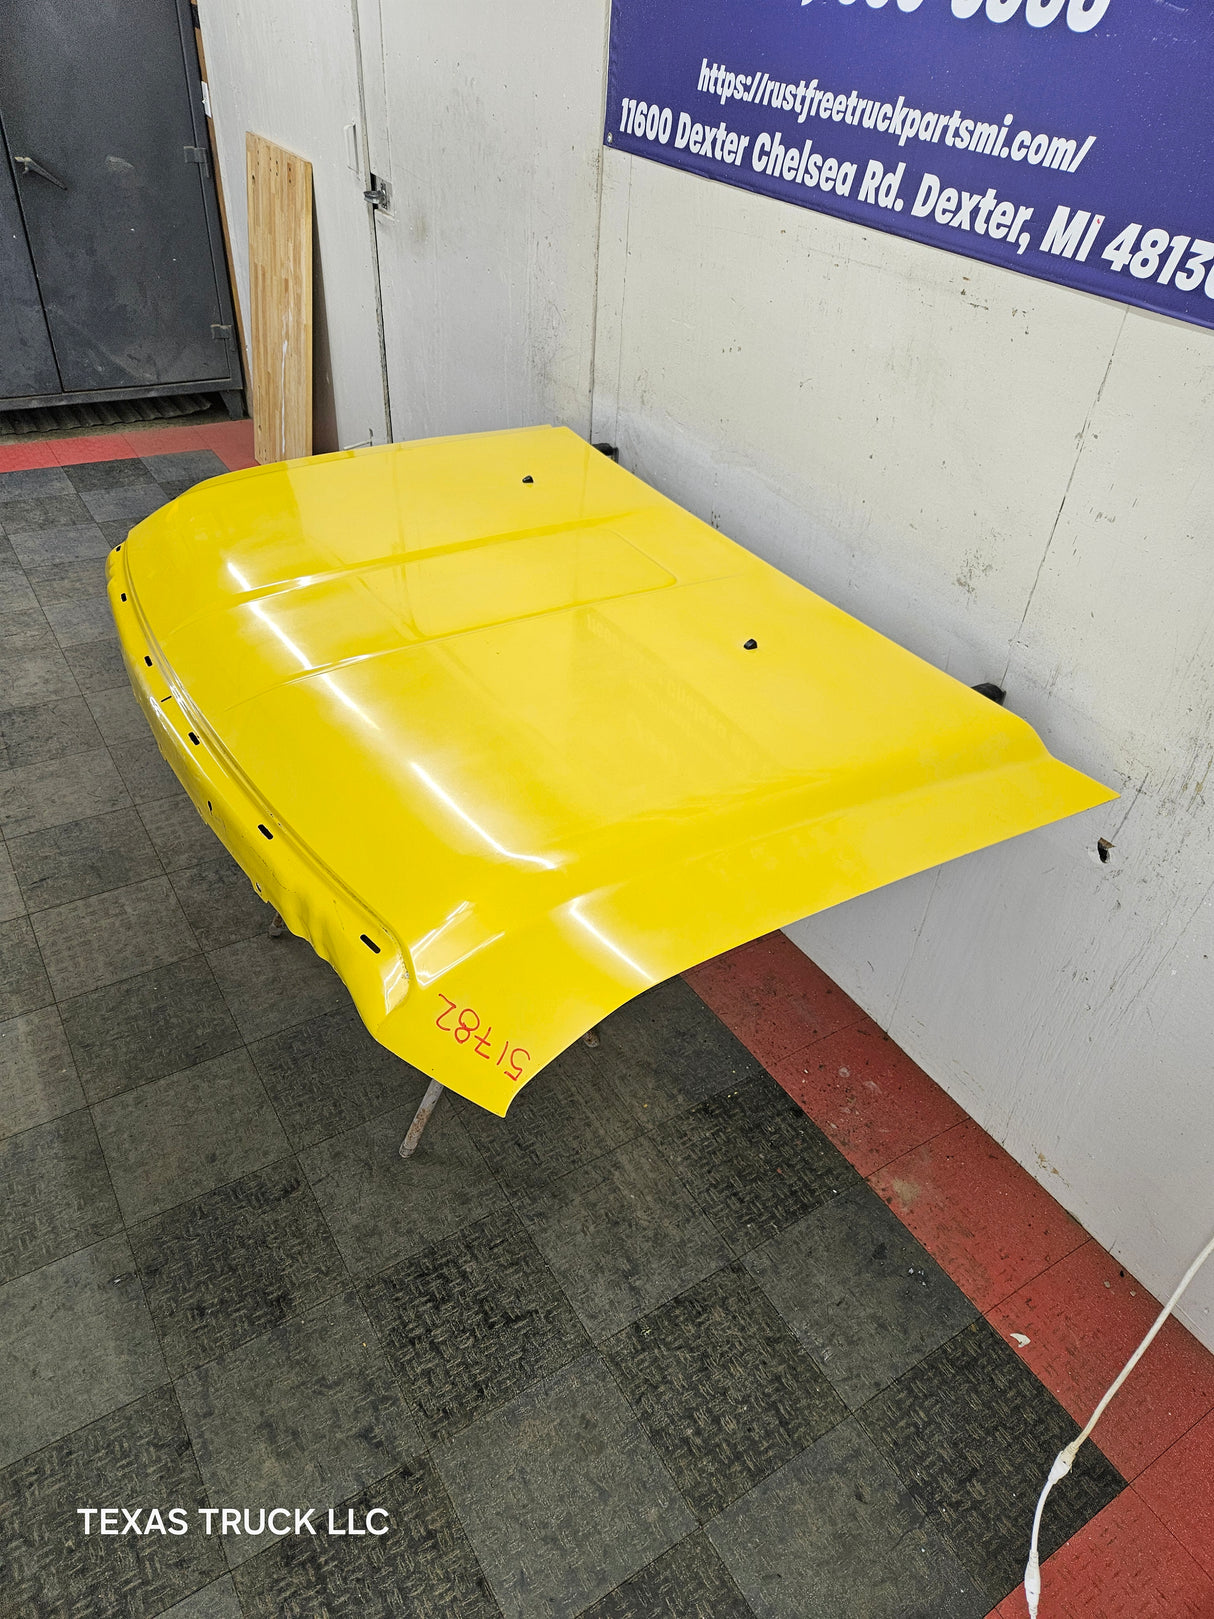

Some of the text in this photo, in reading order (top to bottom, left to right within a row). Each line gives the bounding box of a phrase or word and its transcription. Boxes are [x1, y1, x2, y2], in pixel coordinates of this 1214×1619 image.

[697, 58, 1097, 173] https://rustfreetruckpartsmi.com/
[619, 98, 672, 145] 11600
[675, 112, 749, 166] Dexter
[751, 132, 857, 198] Chelsea
[858, 160, 906, 212] Rd.
[911, 173, 1034, 256] Dexter,
[1039, 205, 1106, 263] MI
[436, 993, 531, 1081] 51782
